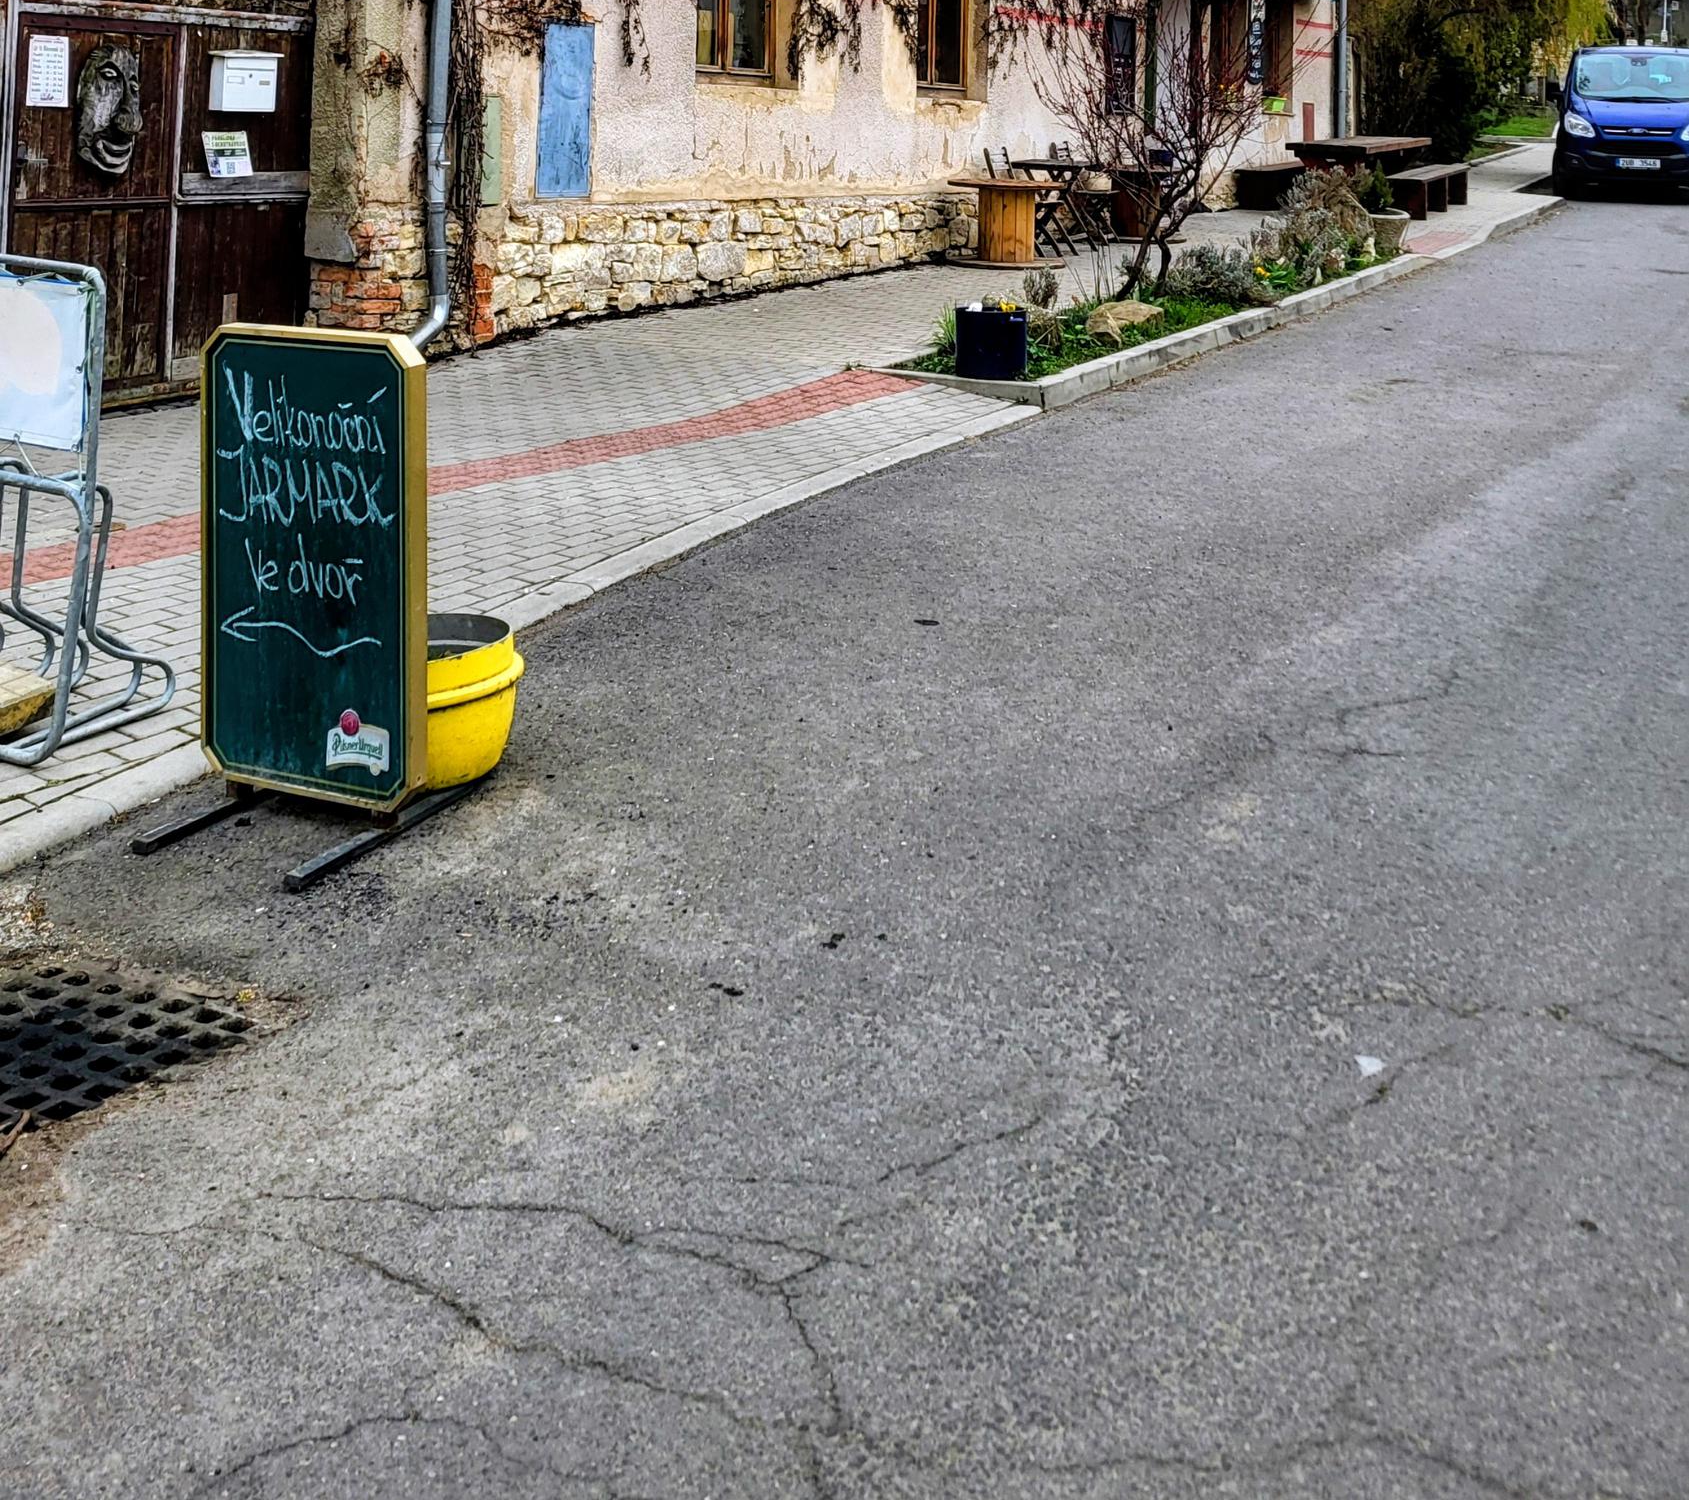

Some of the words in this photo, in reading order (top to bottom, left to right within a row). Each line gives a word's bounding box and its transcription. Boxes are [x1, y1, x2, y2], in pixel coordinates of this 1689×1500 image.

[222, 360, 388, 454] Velikonoční
[217, 445, 397, 528] JARMARK
[331, 733, 357, 757] Pilsner
[358, 736, 384, 759] Urquell
